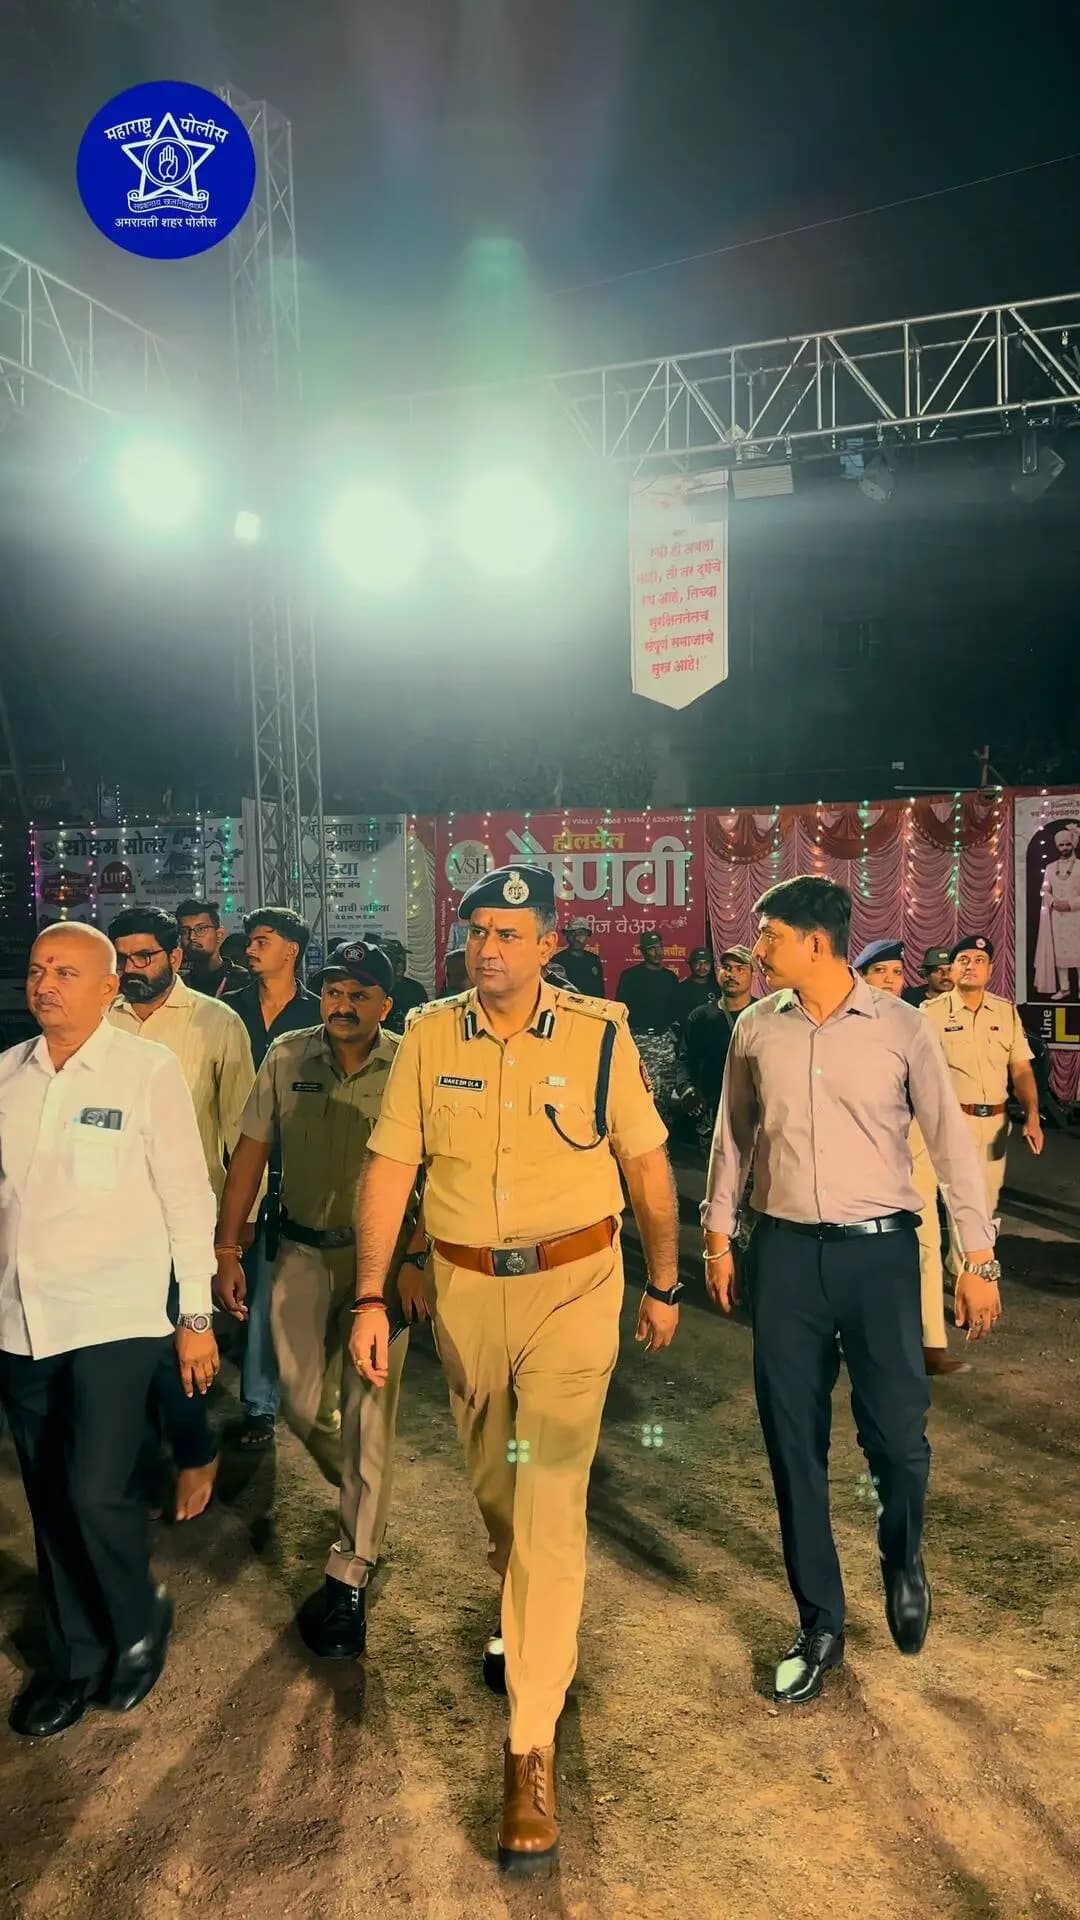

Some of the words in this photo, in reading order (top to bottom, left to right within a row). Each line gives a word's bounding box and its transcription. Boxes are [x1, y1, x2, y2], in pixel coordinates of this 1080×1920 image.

[687, 585, 718, 600] तिच्या
[63, 832, 119, 855] सोहम
[124, 831, 168, 855] सोलर
[552, 826, 625, 852] होलसेल
[453, 854, 487, 874] VSH
[1041, 1010, 1052, 1038] Line
